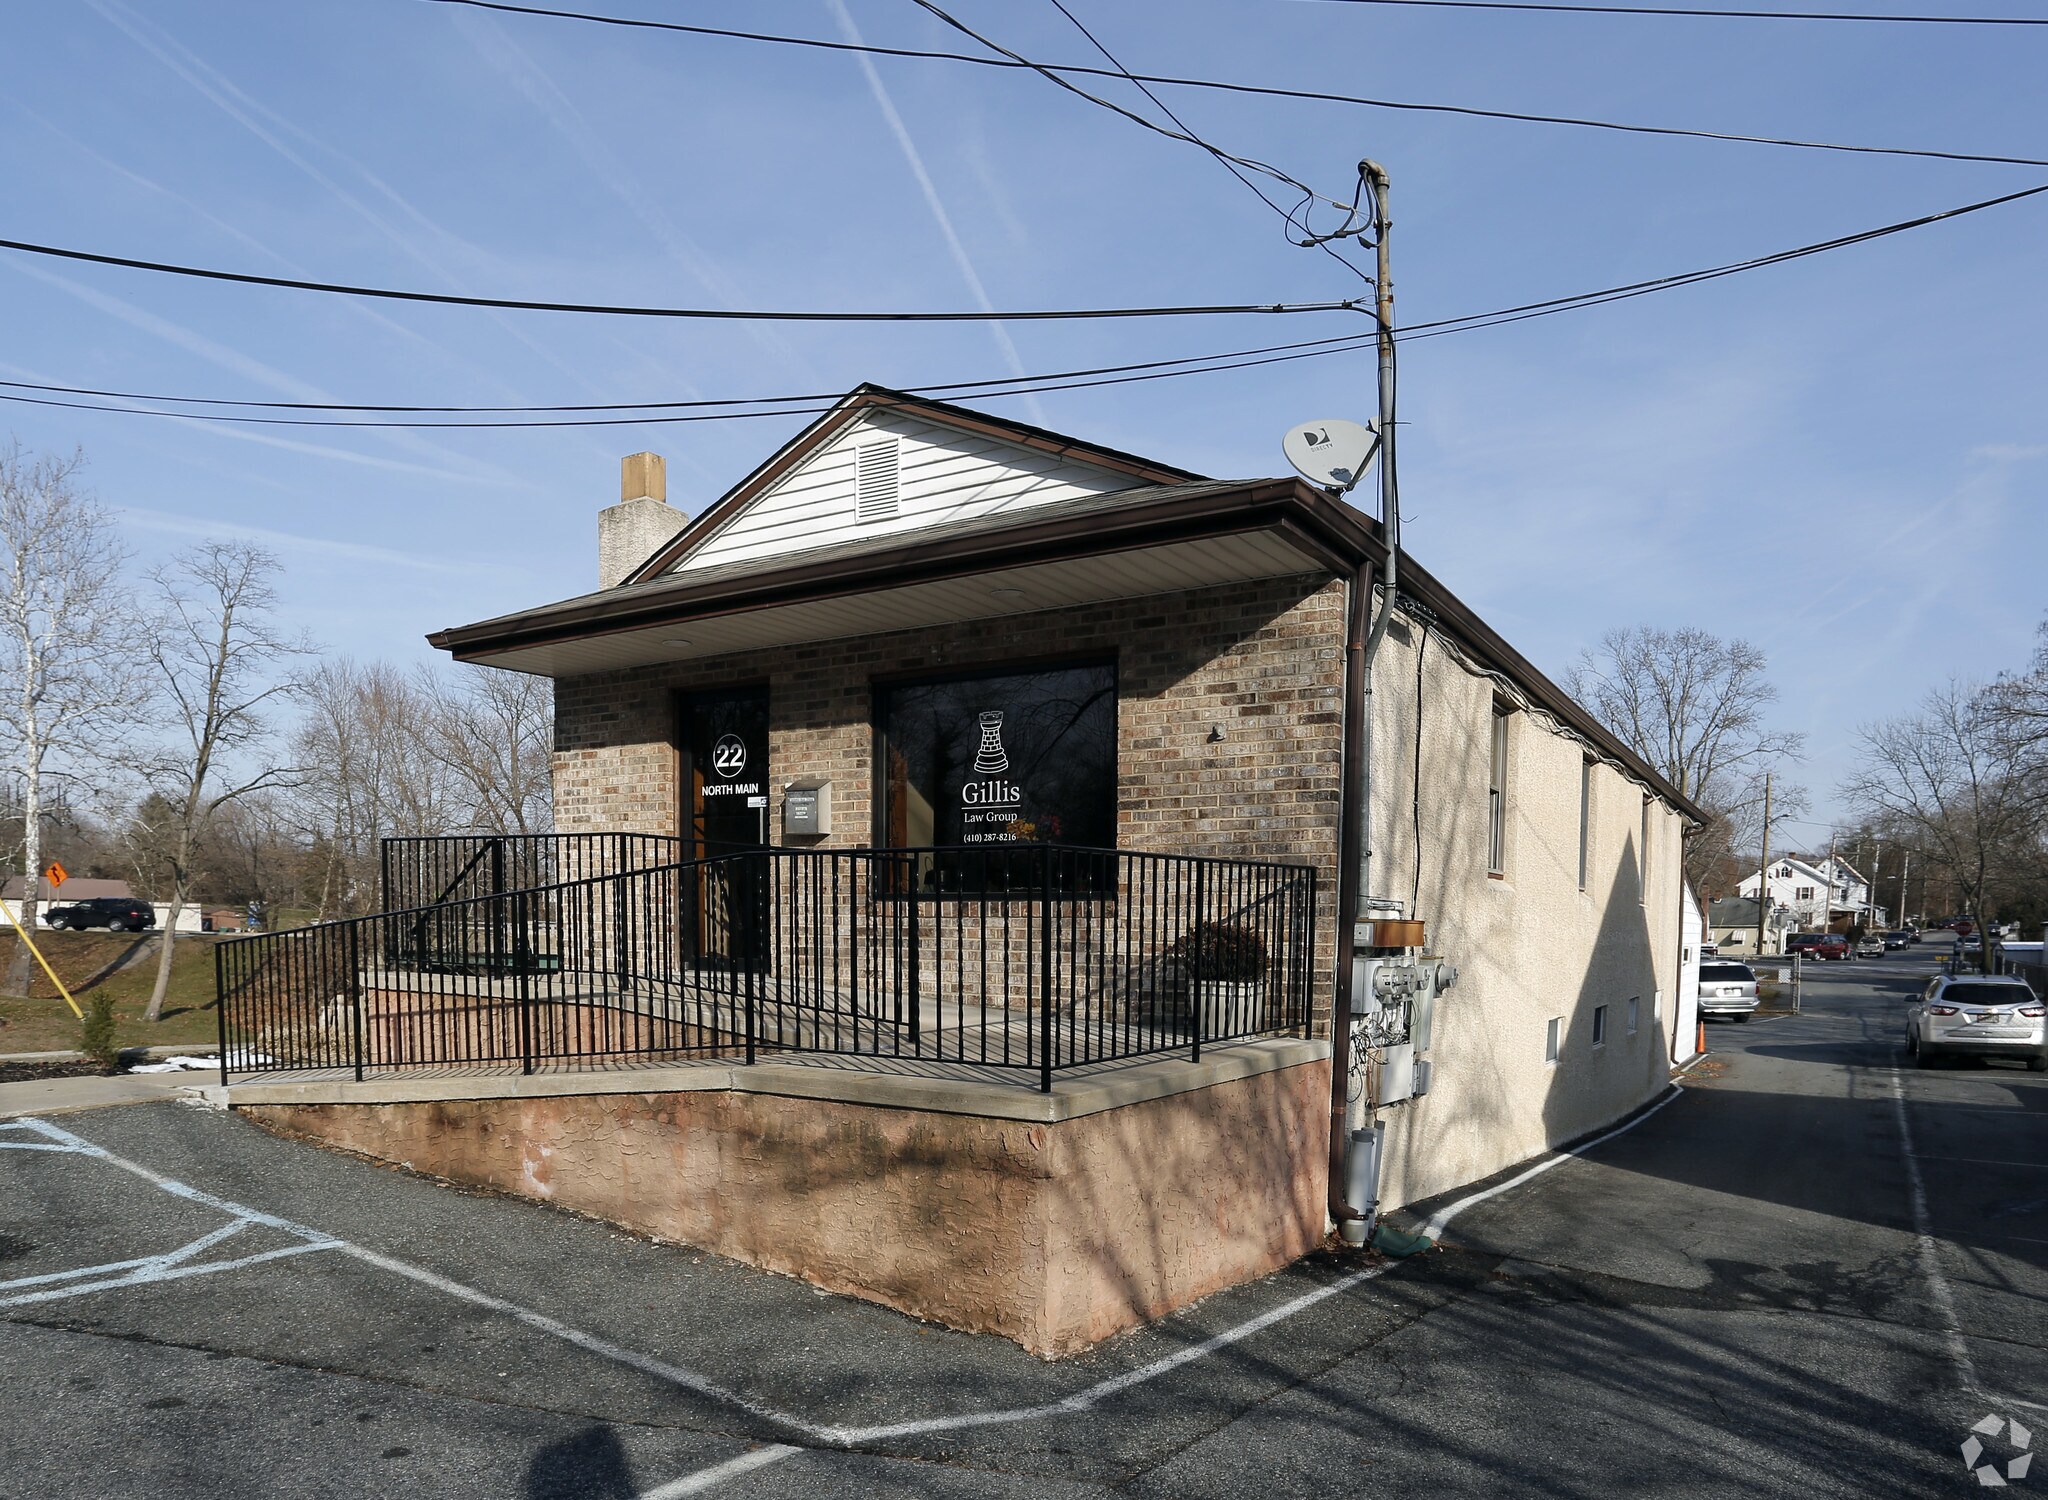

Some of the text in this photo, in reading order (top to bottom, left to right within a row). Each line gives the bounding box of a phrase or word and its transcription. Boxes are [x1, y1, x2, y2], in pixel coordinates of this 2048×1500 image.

[1310, 443, 1334, 453] DIRECTV
[717, 744, 743, 768] 22
[702, 783, 759, 797] NORTH MAIN
[962, 780, 1021, 804] Gillis
[964, 812, 1018, 824] Law Group
[963, 833, 1017, 843] (410) 287-8216
